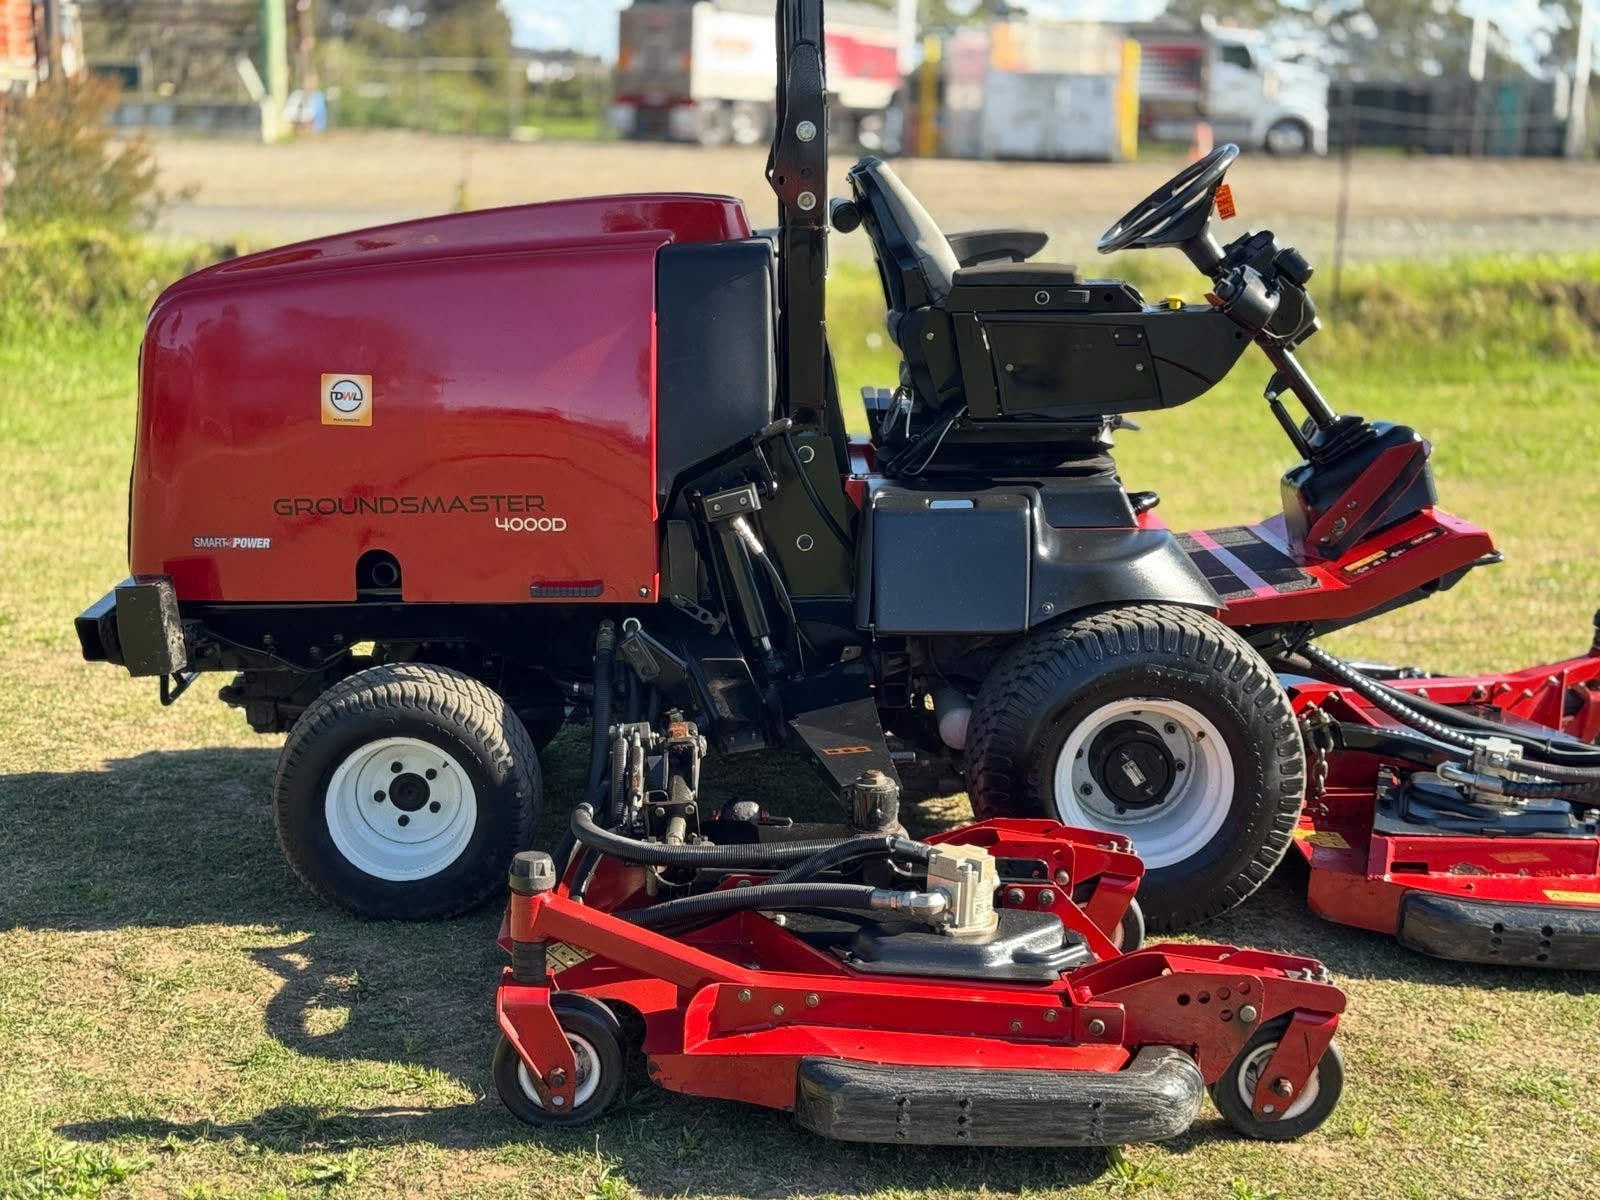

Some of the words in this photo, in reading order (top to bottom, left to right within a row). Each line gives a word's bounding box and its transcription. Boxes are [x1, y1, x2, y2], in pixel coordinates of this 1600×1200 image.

[331, 391, 362, 401] DWL
[274, 495, 546, 516] GROUNDSMASTER
[495, 517, 567, 532] 4000D
[194, 537, 226, 548] SMART
[232, 537, 271, 549] POWER
